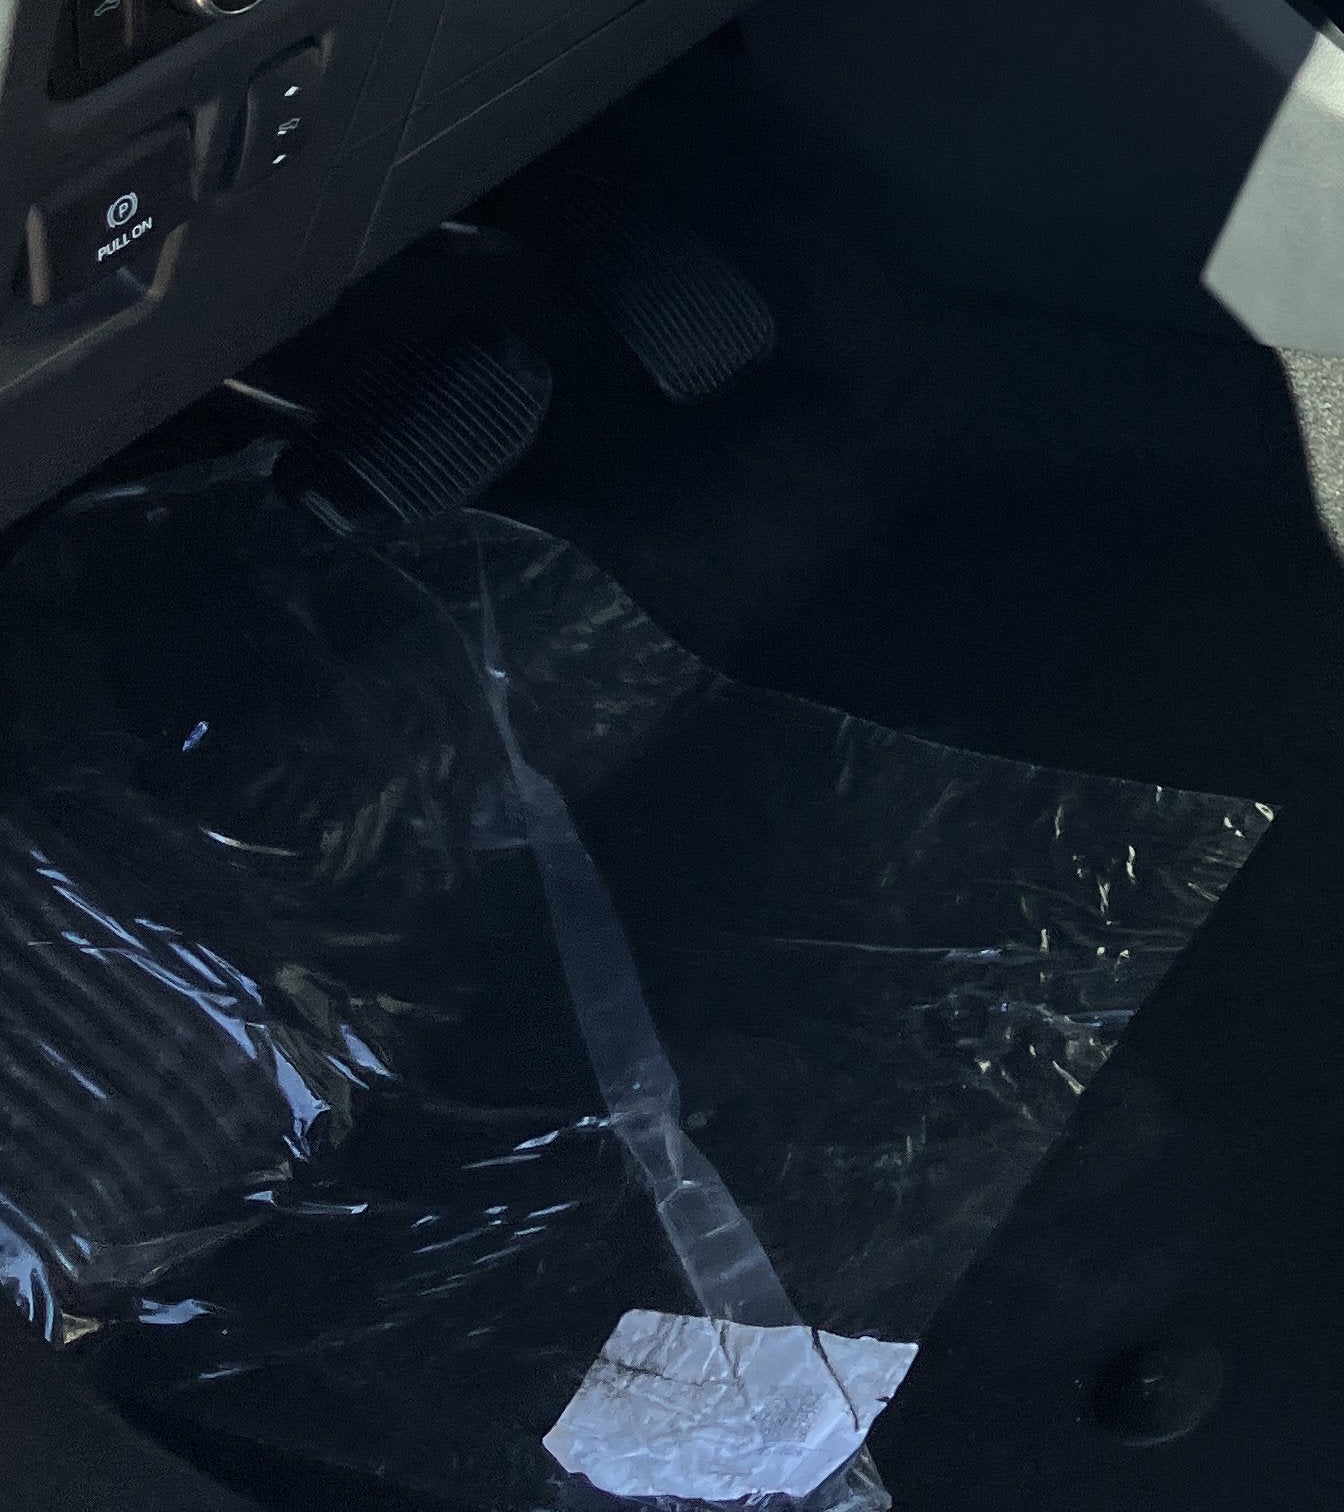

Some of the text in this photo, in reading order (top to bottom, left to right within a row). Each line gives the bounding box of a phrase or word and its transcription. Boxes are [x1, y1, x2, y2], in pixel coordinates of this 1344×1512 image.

[118, 202, 129, 219] P
[97, 216, 153, 262] PULL ON
